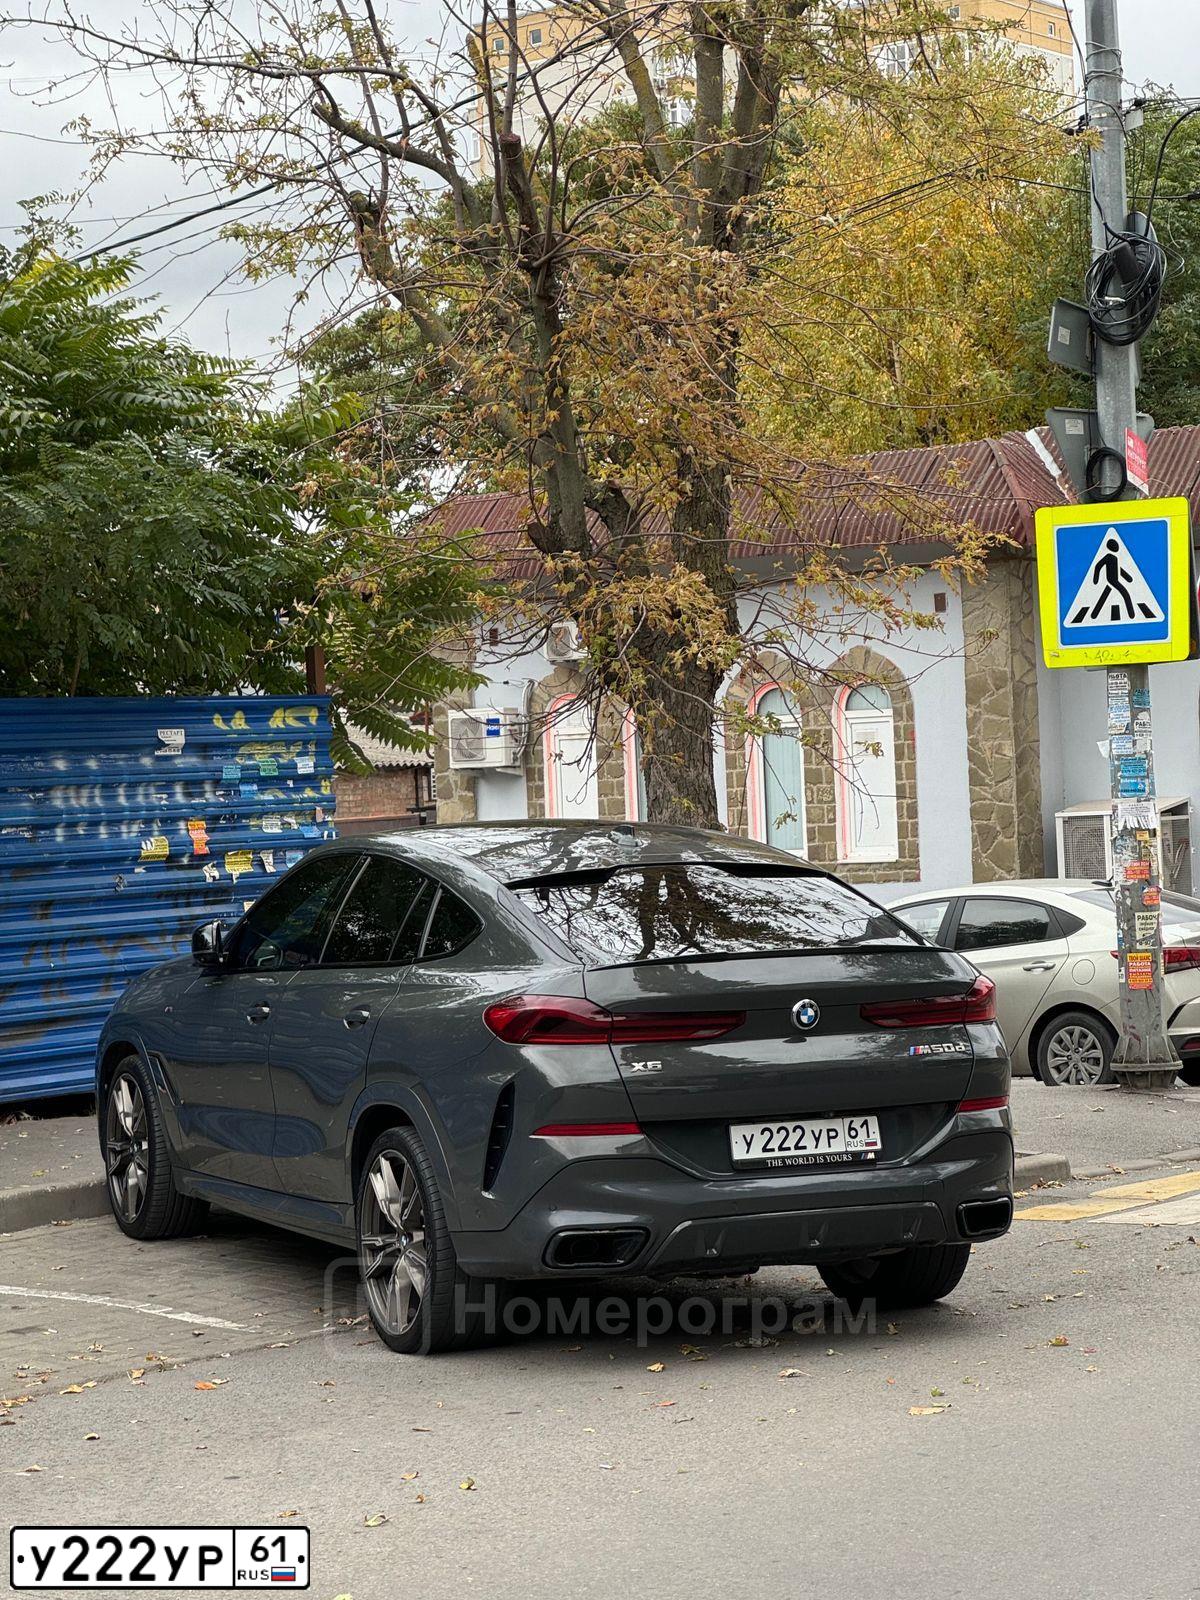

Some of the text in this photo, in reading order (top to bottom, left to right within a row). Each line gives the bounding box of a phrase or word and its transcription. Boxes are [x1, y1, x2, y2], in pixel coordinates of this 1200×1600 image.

[630, 1060, 662, 1072] X6
[742, 1118, 871, 1154] У222УР 61
[846, 1139, 864, 1148] RUS
[766, 1153, 853, 1168] THE WORLD IS YOURS
